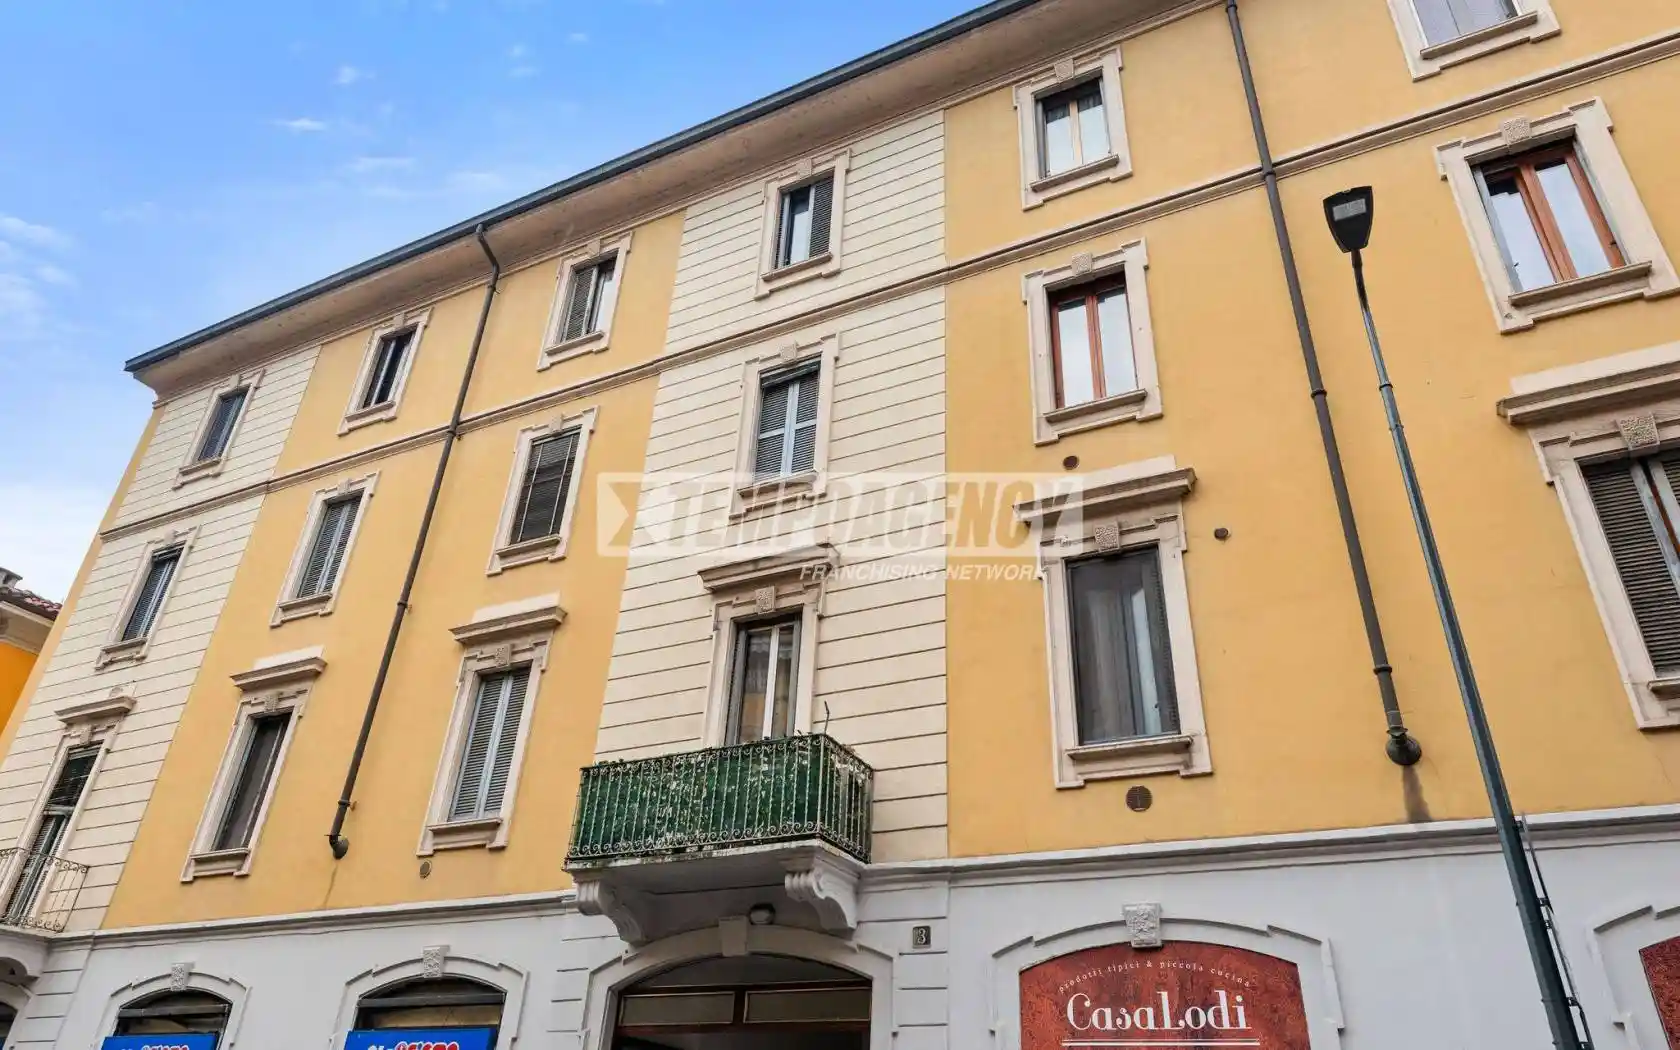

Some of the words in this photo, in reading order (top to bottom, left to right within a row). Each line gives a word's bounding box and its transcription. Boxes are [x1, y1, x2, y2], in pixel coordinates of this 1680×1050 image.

[1058, 968, 1103, 995] prodotti
[1107, 960, 1141, 973] tipici
[1159, 959, 1203, 972] piccola
[1210, 967, 1250, 987] cucina
[1066, 989, 1252, 1031] CasaLodi
